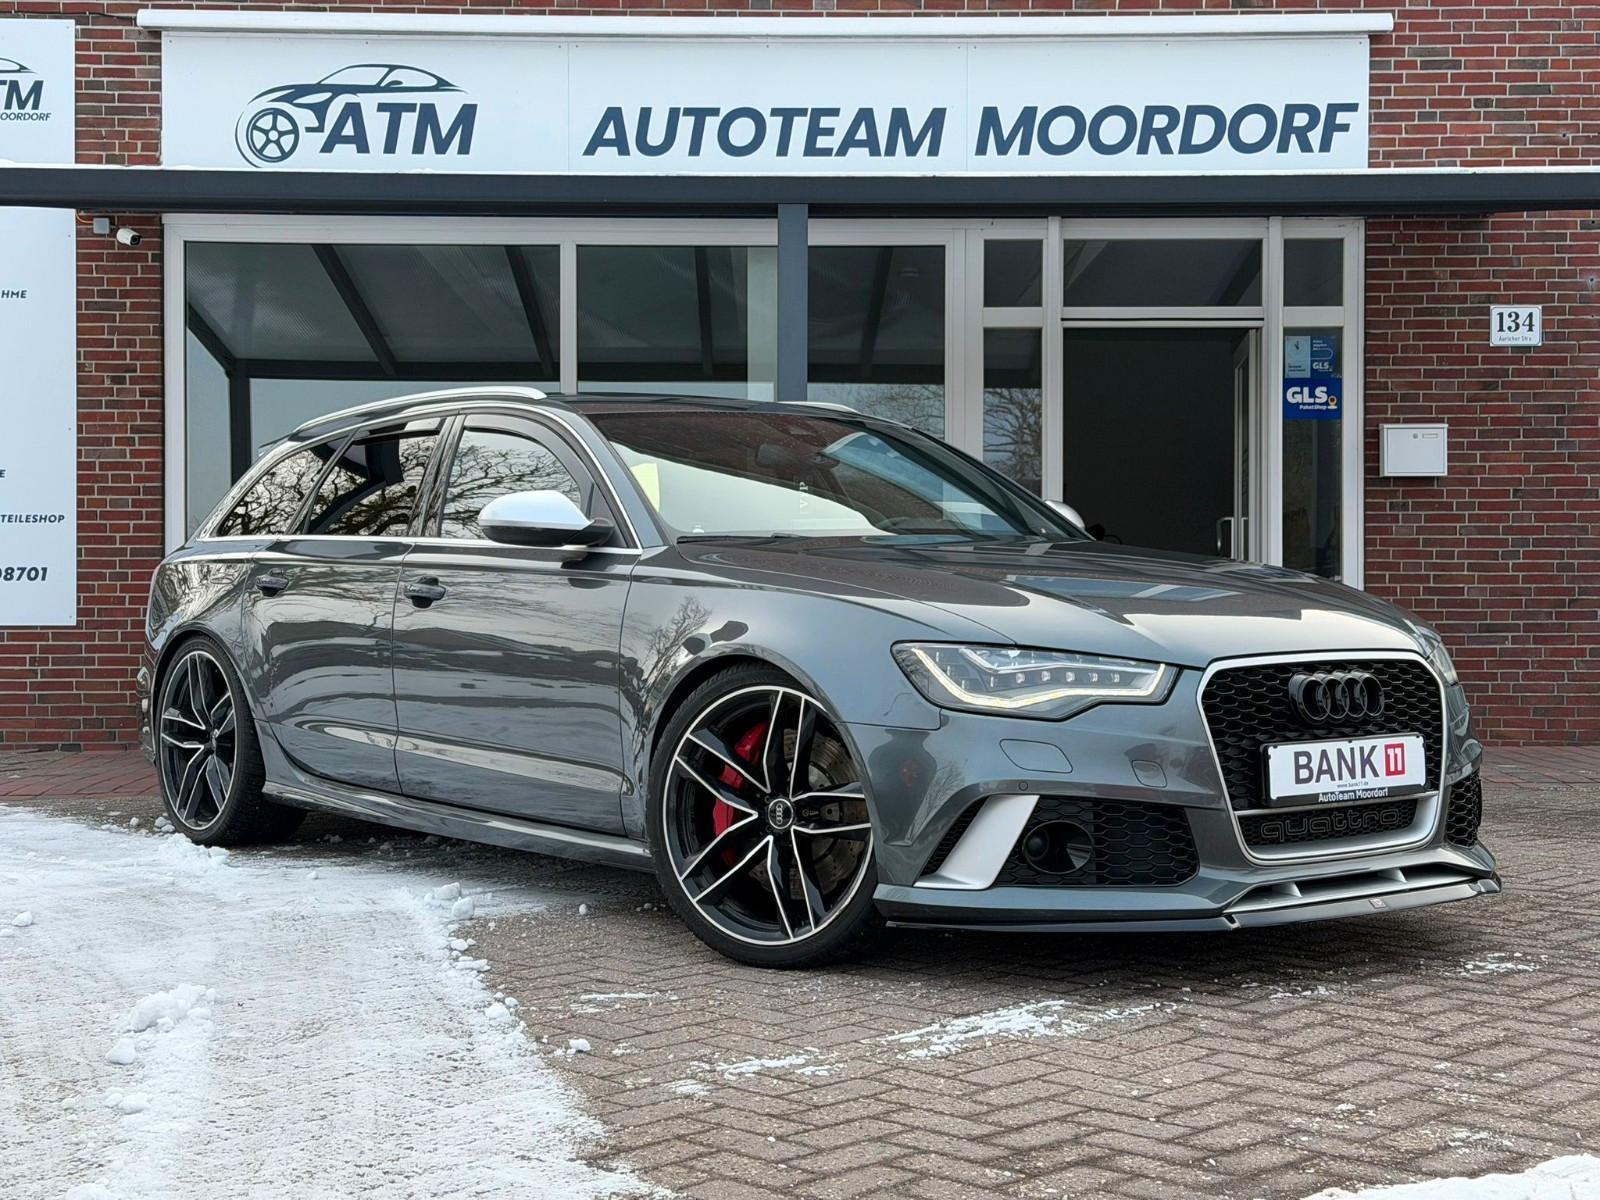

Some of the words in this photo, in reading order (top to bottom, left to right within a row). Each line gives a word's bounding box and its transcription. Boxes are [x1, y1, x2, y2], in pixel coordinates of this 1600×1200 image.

[319, 102, 478, 155] ATM
[582, 106, 947, 158] AUTOTEAM
[974, 102, 1360, 156] MOORDORF
[1496, 311, 1535, 333] 134
[1312, 362, 1329, 370] GLS
[1286, 386, 1328, 404] GLS
[0, 566, 48, 582] 8701
[1293, 745, 1380, 785] BANK
[1318, 790, 1355, 803] AutoTeam
[1356, 787, 1389, 799] Moordorf
[1260, 808, 1400, 842] quattro
